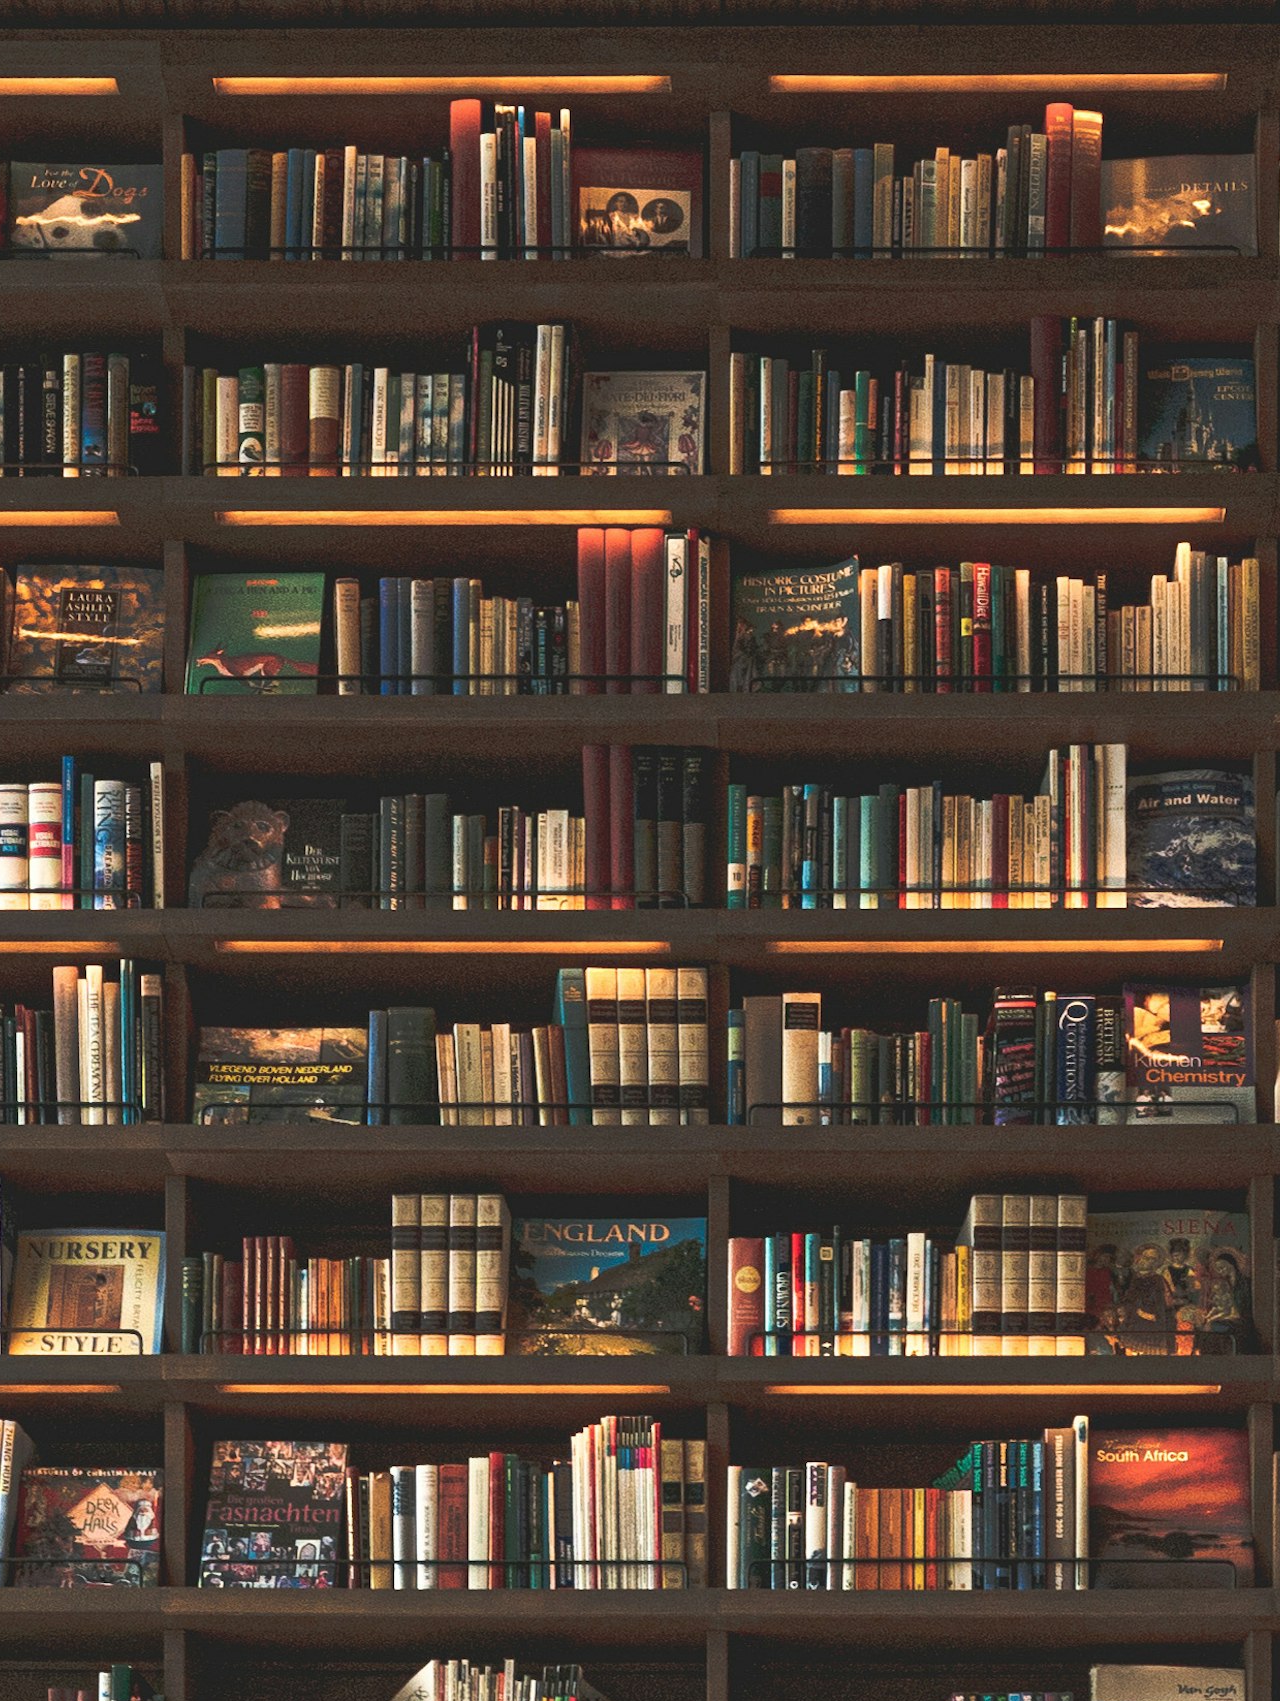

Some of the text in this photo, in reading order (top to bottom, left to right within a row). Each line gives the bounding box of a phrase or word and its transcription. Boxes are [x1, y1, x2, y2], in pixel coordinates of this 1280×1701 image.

[69, 592, 113, 602] LAURA
[66, 603, 112, 613] ASHLEY
[69, 613, 110, 623] STYLE
[1134, 1053, 1202, 1068] Kitchen
[1145, 1069, 1247, 1087] Chemistry
[522, 1222, 671, 1245] ENGLAND
[28, 1239, 153, 1261] NURSERY
[41, 1334, 123, 1354] STYLE
[1096, 1450, 1188, 1462] South Africa
